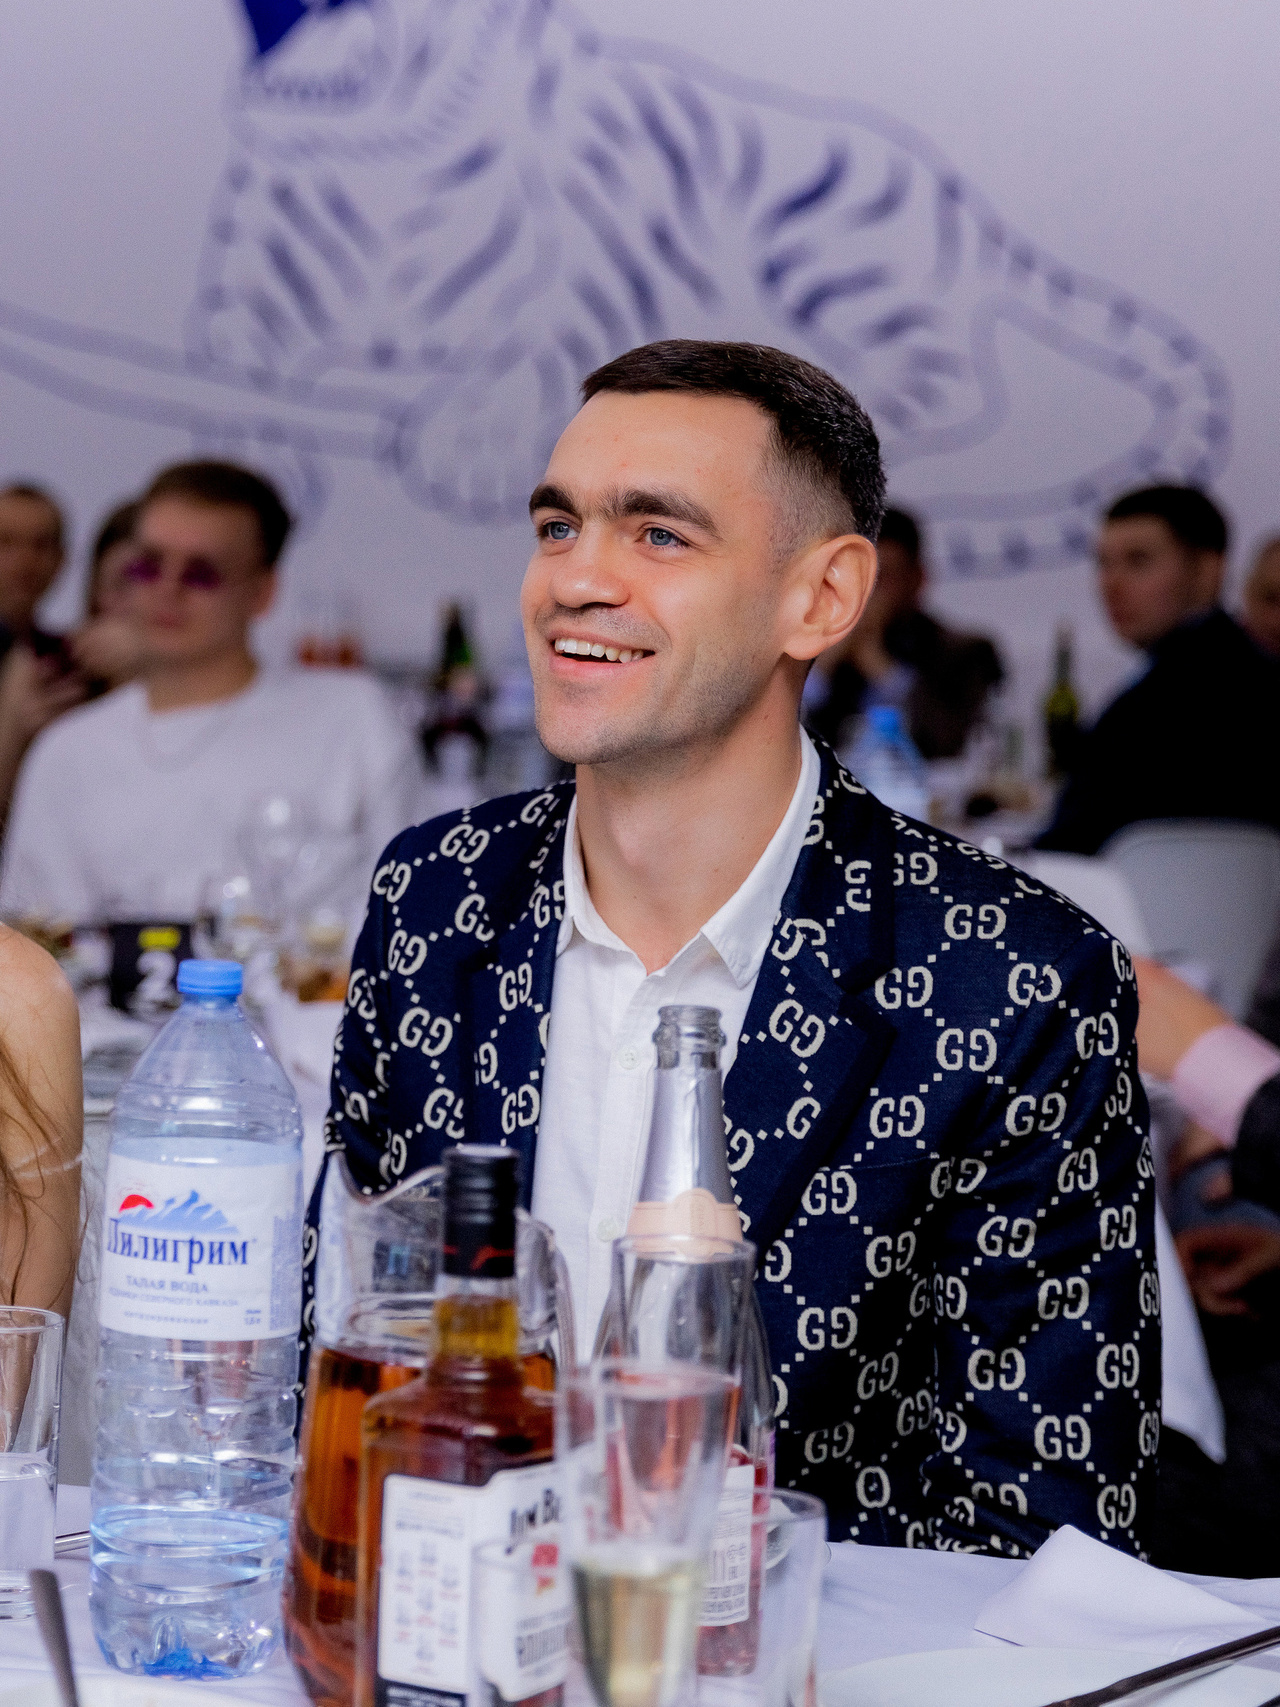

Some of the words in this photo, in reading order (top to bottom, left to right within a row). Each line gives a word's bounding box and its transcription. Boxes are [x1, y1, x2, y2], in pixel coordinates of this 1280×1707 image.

[944, 903, 1007, 941] GG
[874, 965, 934, 1010] GG
[398, 1006, 453, 1058] GG
[935, 1027, 998, 1073] GG
[869, 1094, 926, 1139] GG
[801, 1170, 858, 1216] GG
[106, 1217, 250, 1276] Пилигрим
[125, 1275, 166, 1291] ТАЛАЯ
[170, 1280, 209, 1295] ВОДА
[1037, 1276, 1090, 1320] GG
[796, 1306, 858, 1351] GG
[967, 1348, 1027, 1391] GG
[1096, 1343, 1140, 1389] GG
[1034, 1414, 1092, 1461] GG
